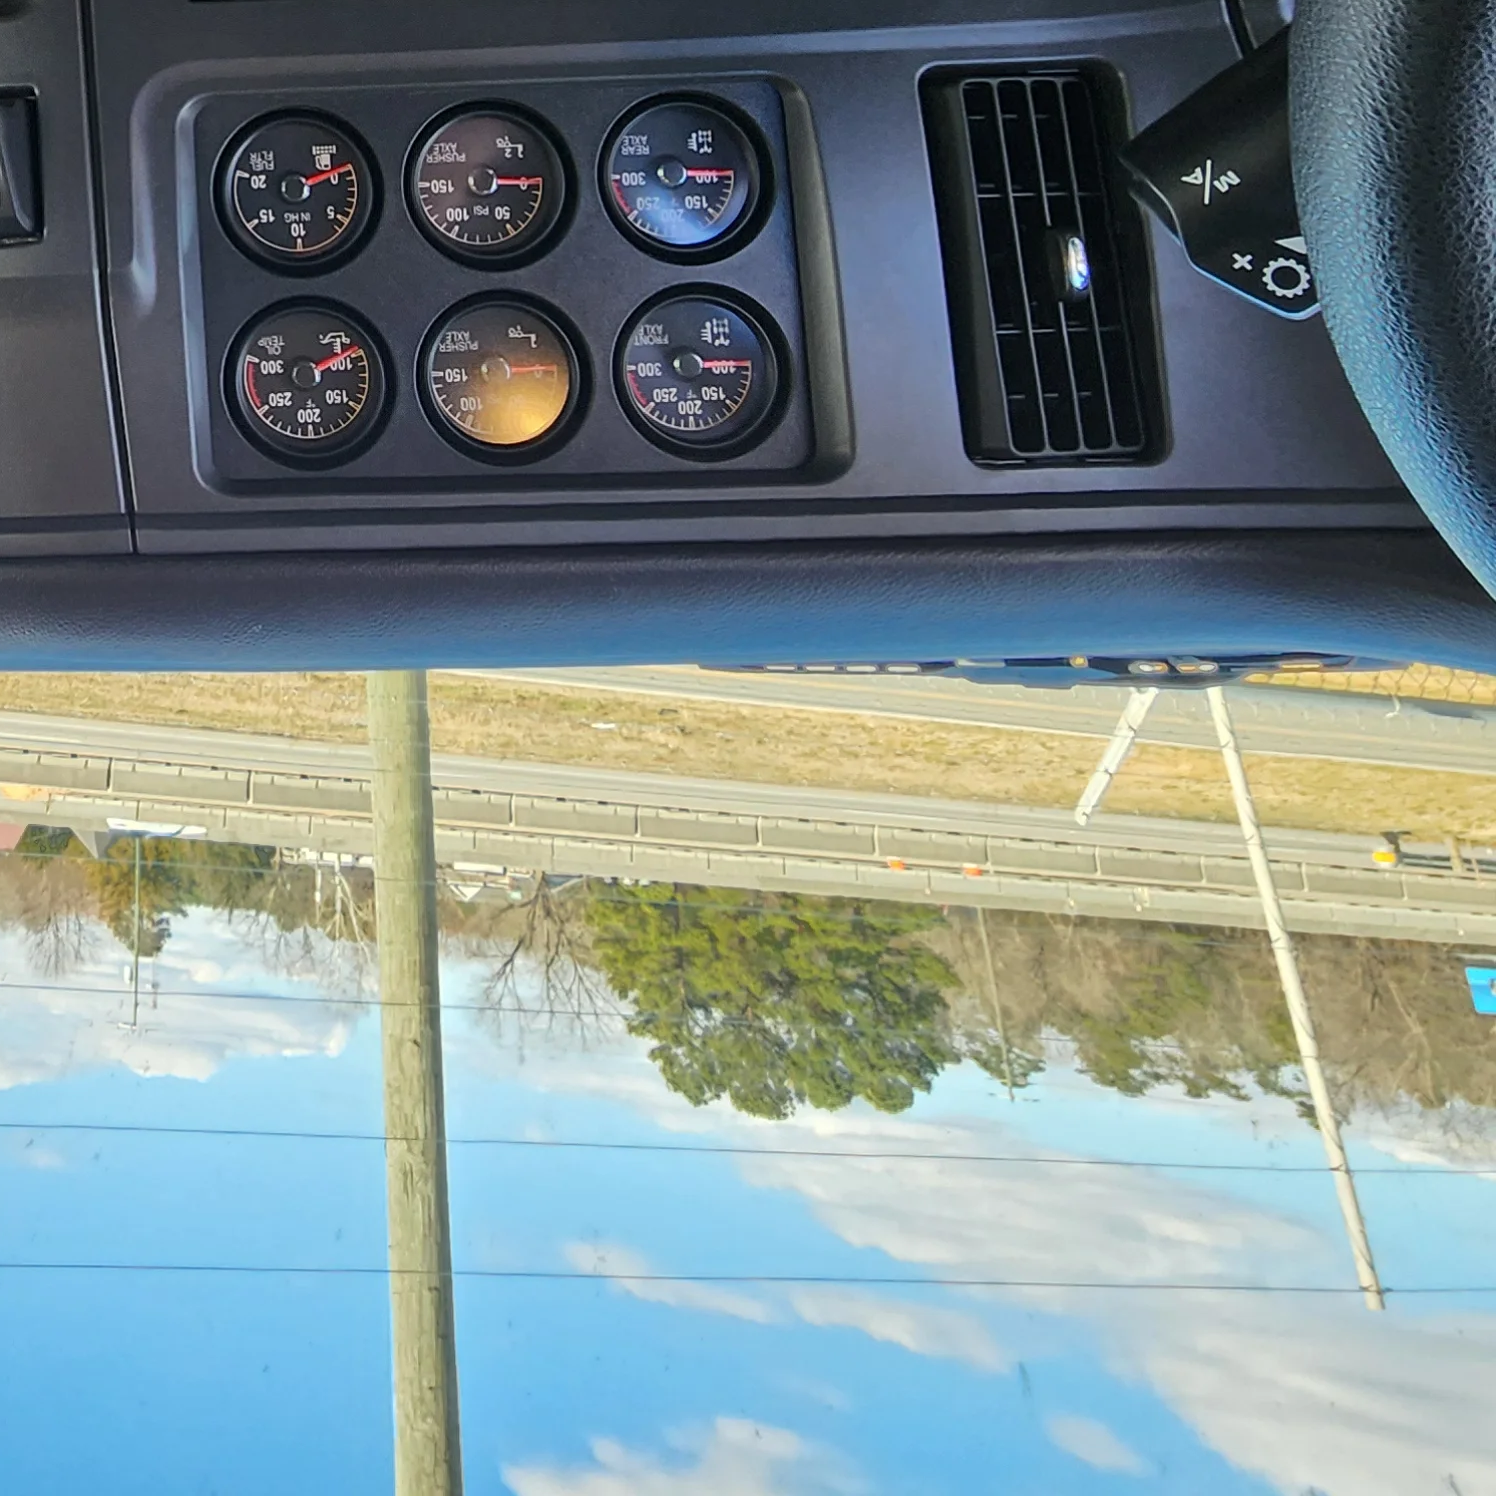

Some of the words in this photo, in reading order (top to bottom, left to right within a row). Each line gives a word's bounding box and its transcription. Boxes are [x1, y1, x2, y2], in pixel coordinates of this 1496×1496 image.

[623, 135, 648, 145] AXLE
[433, 142, 457, 153] AXLE
[621, 144, 650, 155] REAR
[250, 150, 273, 162] FLTR
[426, 152, 466, 163] PUSHER
[250, 160, 275, 171] FUEL
[250, 175, 267, 189] 20
[622, 172, 645, 185] 300
[431, 180, 454, 193] 150
[637, 197, 660, 210] 250
[685, 195, 708, 209] 150
[259, 209, 275, 223] 15
[284, 212, 299, 222] HG
[301, 212, 311, 221] IN
[327, 205, 335, 219] 5
[446, 207, 470, 221] 100
[473, 205, 489, 216] PSI
[495, 206, 511, 220] 50
[291, 223, 306, 237] 10
[638, 324, 663, 335] AXLE
[257, 335, 285, 346] TEMP
[446, 331, 470, 343] AXLE
[633, 334, 669, 345] FRONT
[265, 345, 281, 355] OIL
[439, 340, 478, 352] PUSHER
[260, 360, 284, 374] 300
[638, 363, 662, 377] 300
[446, 368, 468, 382] 150
[269, 392, 292, 406] 250
[325, 389, 349, 404] 150
[653, 388, 677, 402] 250
[701, 387, 726, 400] 150
[460, 397, 483, 411] 100
[678, 400, 702, 414] 200
[297, 409, 321, 423] 200
